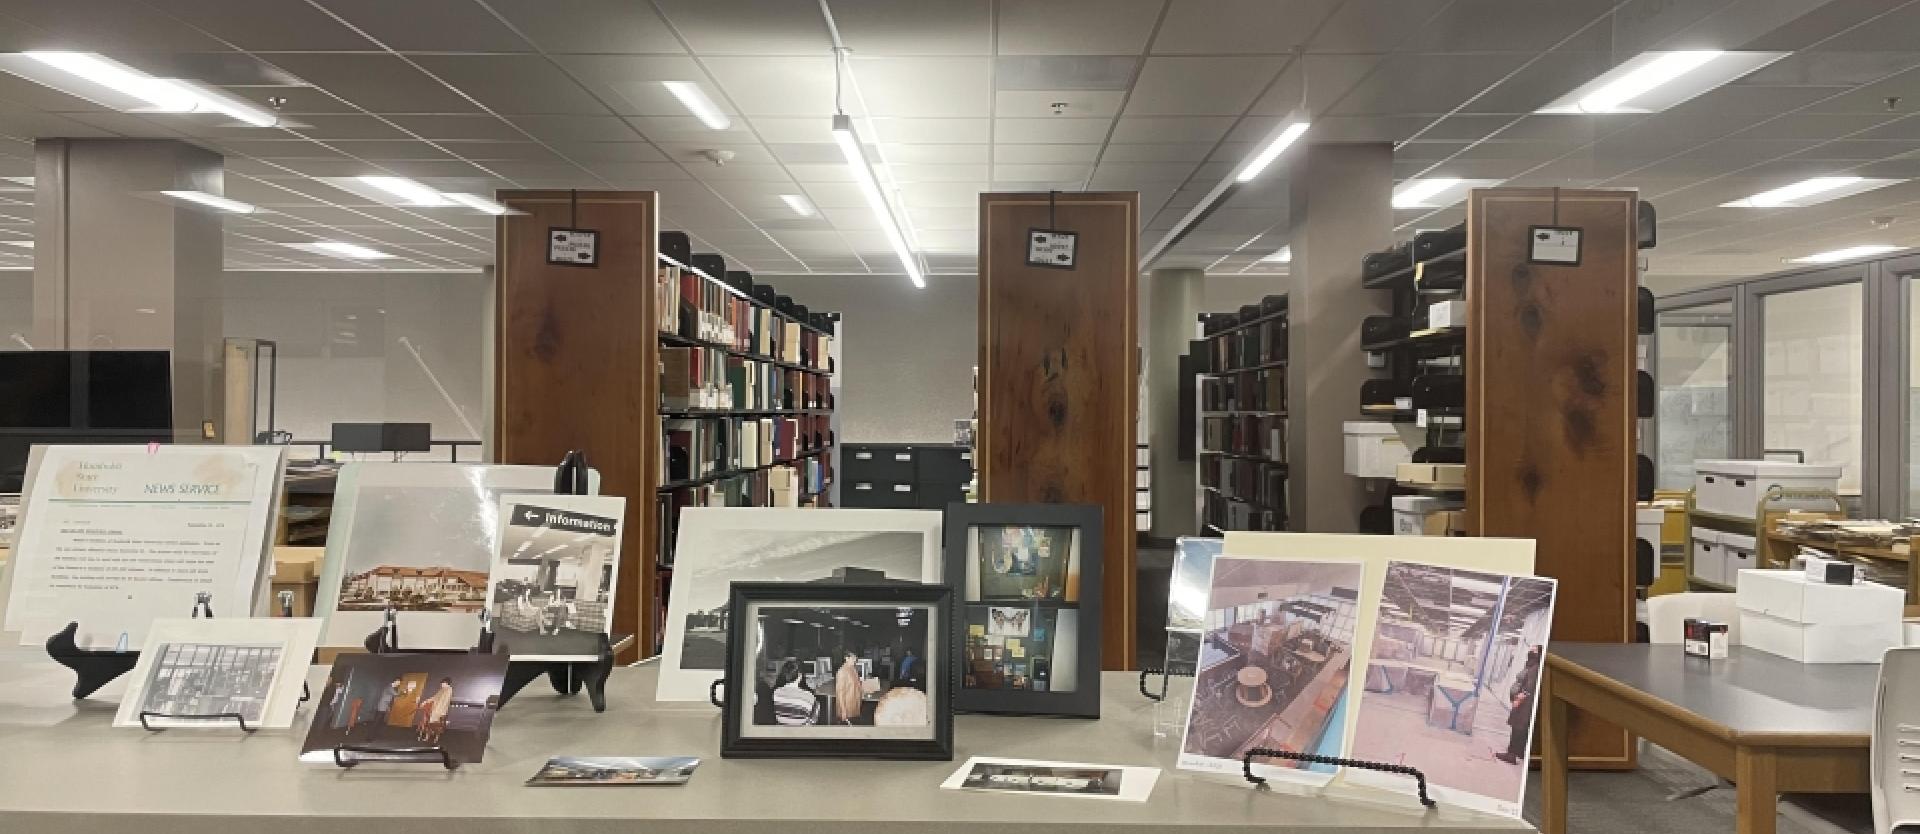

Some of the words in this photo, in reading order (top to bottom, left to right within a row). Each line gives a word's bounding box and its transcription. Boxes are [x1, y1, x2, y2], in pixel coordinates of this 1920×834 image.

[144, 483, 175, 494] NEWS
[178, 483, 221, 495] SERVICE
[545, 512, 611, 531] Information
